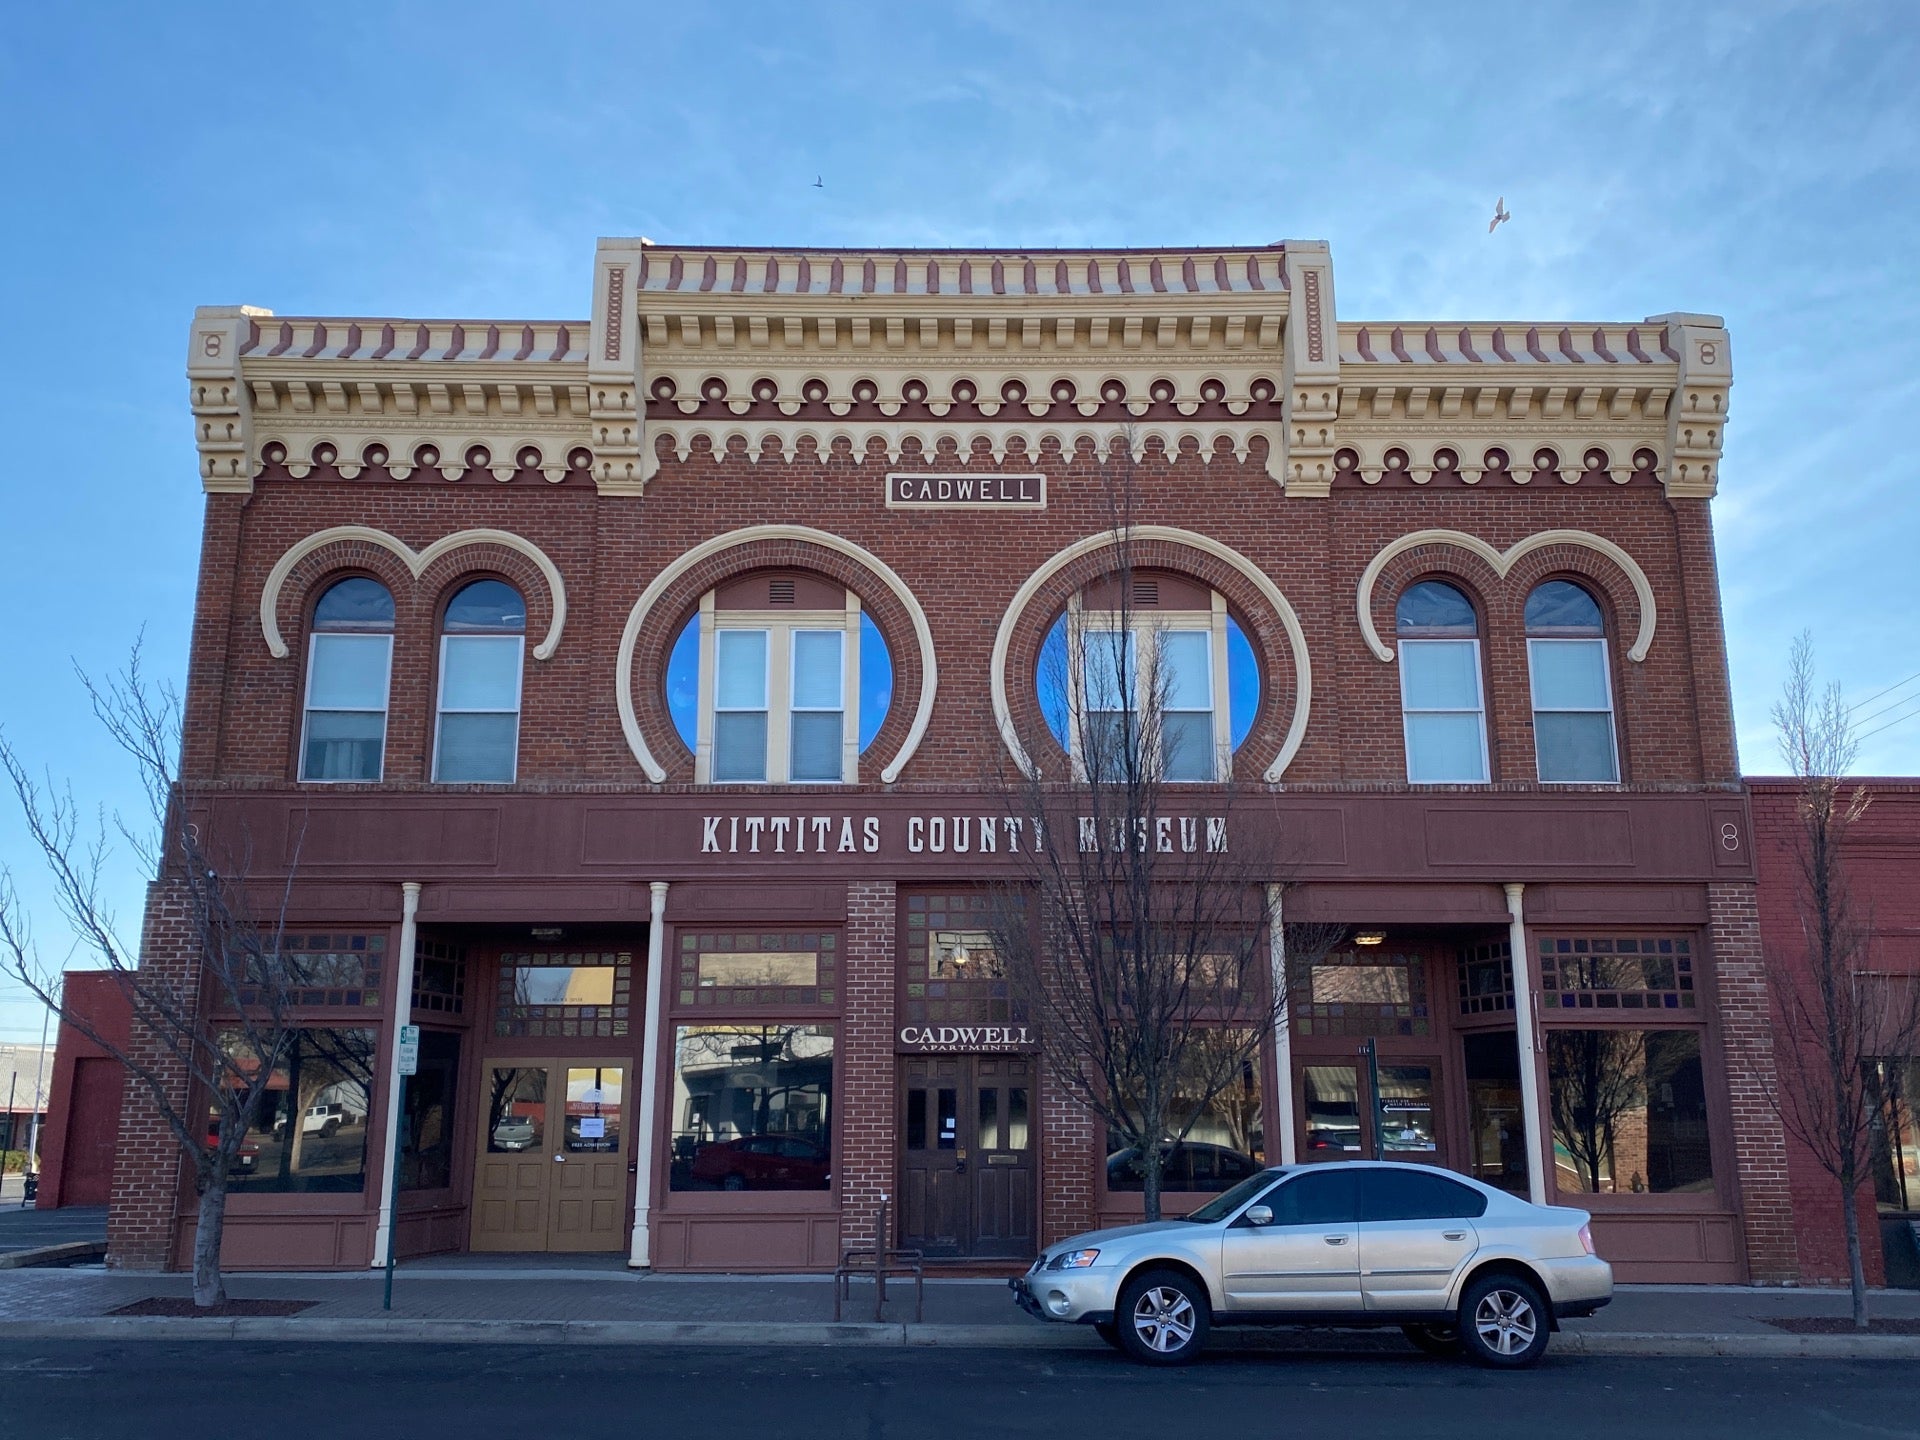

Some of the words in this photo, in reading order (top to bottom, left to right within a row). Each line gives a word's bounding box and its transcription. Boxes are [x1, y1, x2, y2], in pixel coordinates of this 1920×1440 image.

[899, 480, 1033, 500] CADWELL
[701, 816, 880, 853] KITTITAS
[401, 1029, 407, 1042] 3
[900, 1026, 1036, 1044] CADWELL
